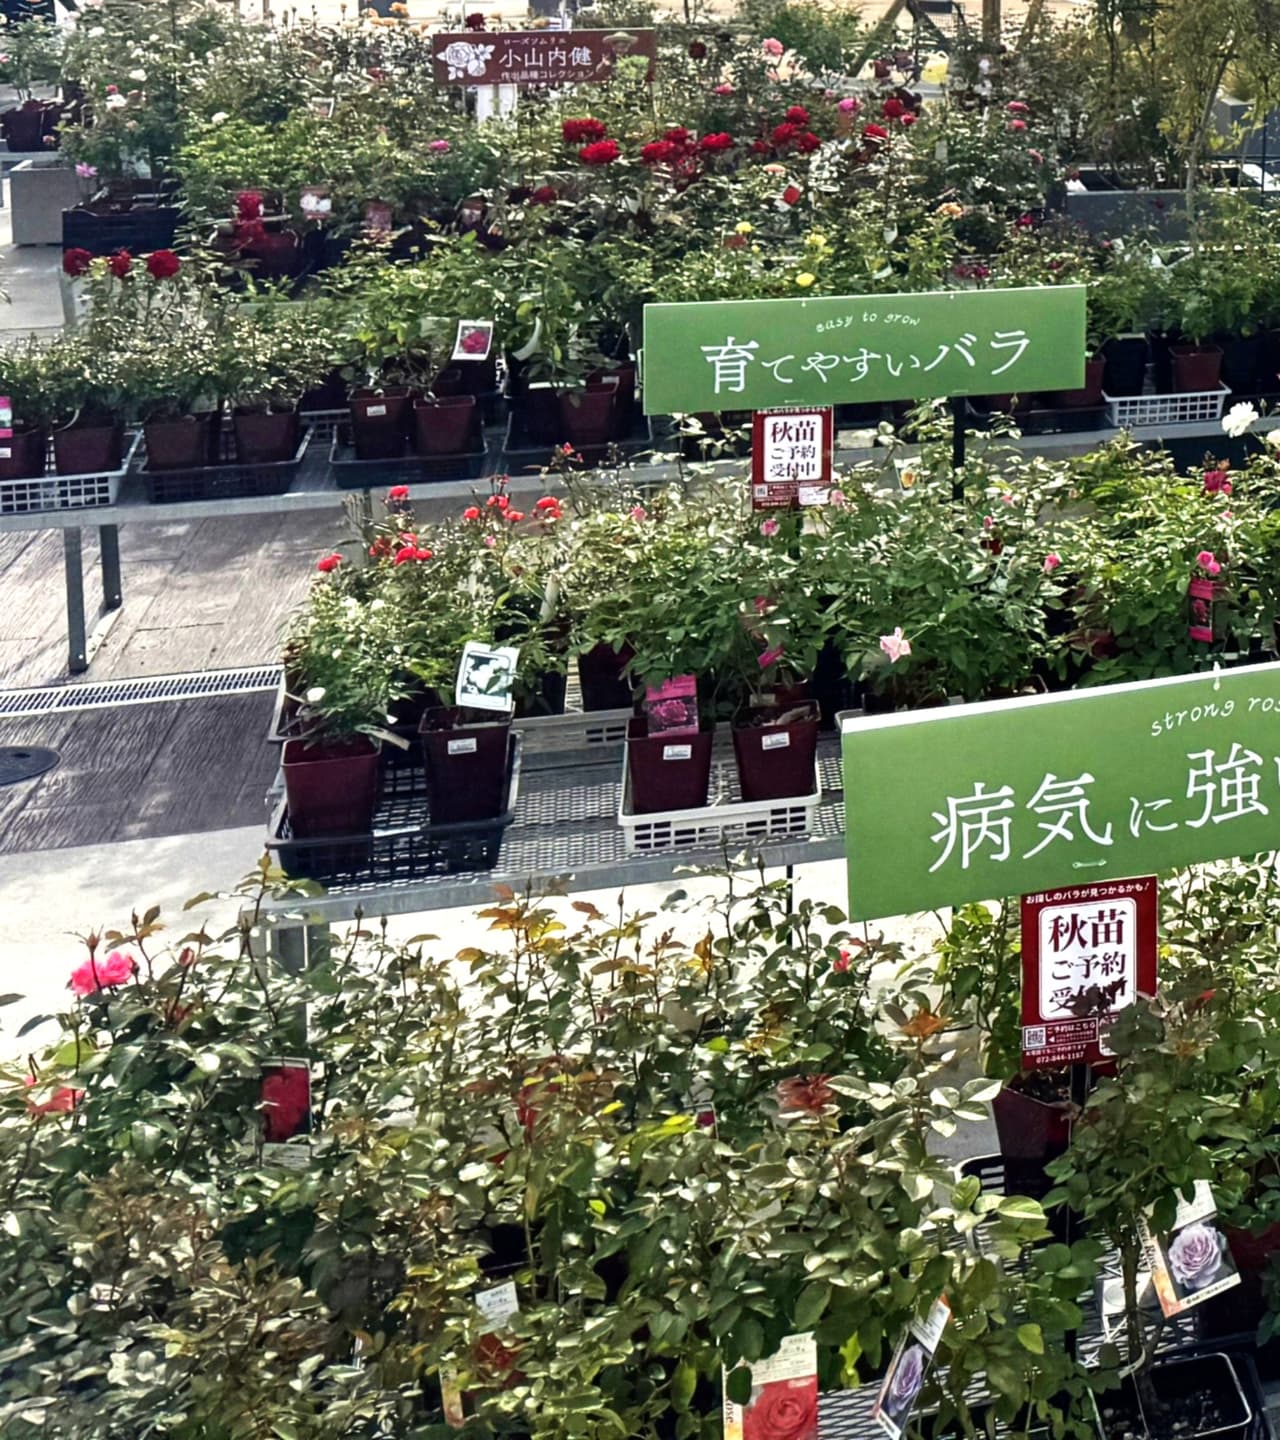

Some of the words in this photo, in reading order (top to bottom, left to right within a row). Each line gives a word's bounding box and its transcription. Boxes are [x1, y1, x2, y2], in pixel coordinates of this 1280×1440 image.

[499, 46, 592, 68] 小山内健
[816, 315, 853, 333] easy
[863, 312, 878, 323] to
[884, 313, 920, 326] grow
[700, 329, 1032, 394] 育てやすいバラ
[771, 420, 816, 444] 秋苗
[771, 445, 816, 460] ご予約
[770, 462, 816, 478] 受付中
[1151, 700, 1235, 737] strong
[1048, 909, 1128, 953] 秋苗
[1051, 951, 1127, 980] ご予約
